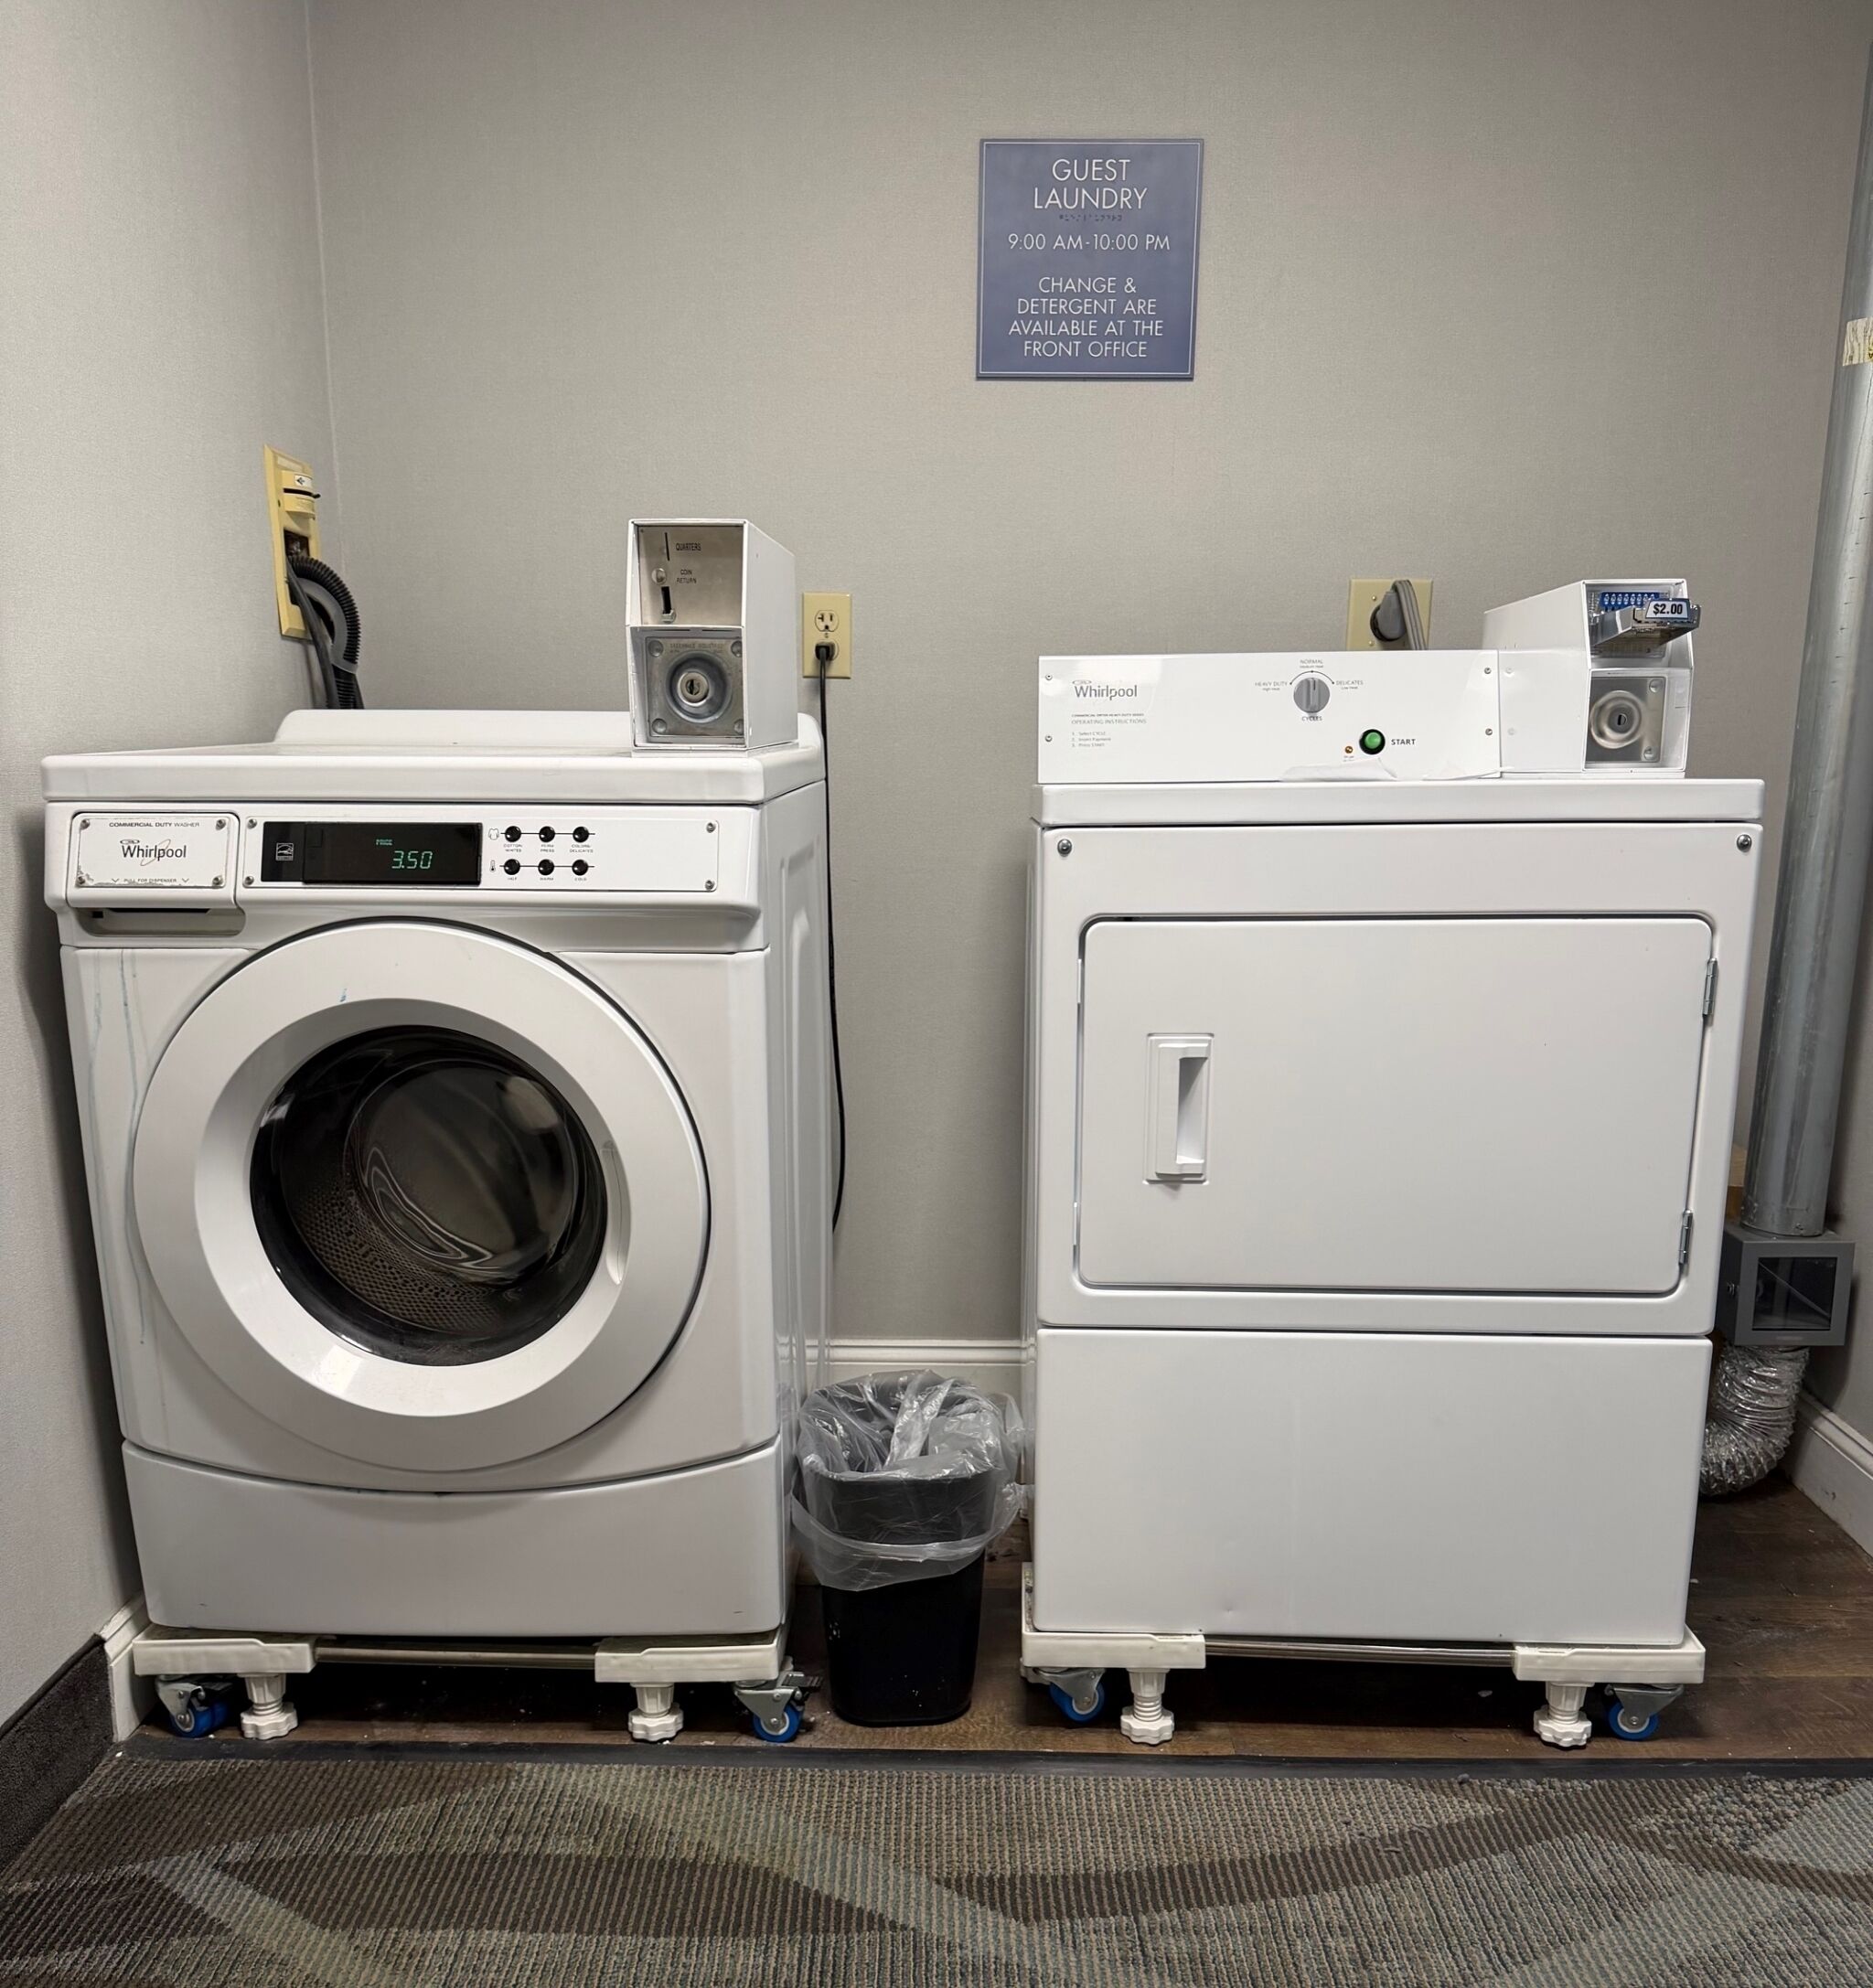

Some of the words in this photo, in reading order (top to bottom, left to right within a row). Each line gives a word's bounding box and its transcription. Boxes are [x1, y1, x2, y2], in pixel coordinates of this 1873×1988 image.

[1052, 159, 1130, 181] GUEST
[1034, 187, 1148, 209] LAUNDRY
[1008, 233, 1046, 250] 9:00
[1145, 235, 1171, 251] PM
[1039, 277, 1117, 294] CHANGE
[1124, 277, 1137, 294] &
[1017, 298, 1117, 315] DETERGENT
[1123, 299, 1157, 315] ARE
[1008, 320, 1097, 336] AVAILABLE
[1104, 320, 1126, 336] AT
[1132, 320, 1163, 336] THE
[1023, 340, 1082, 357] FRONT
[1088, 341, 1148, 358] OFFICE
[675, 542, 701, 551] QUARTERS
[1653, 604, 1683, 615] $2.00
[1075, 684, 1138, 700] Whirlpool
[122, 845, 187, 861] Whirlpool
[391, 850, 433, 869] 3.50
